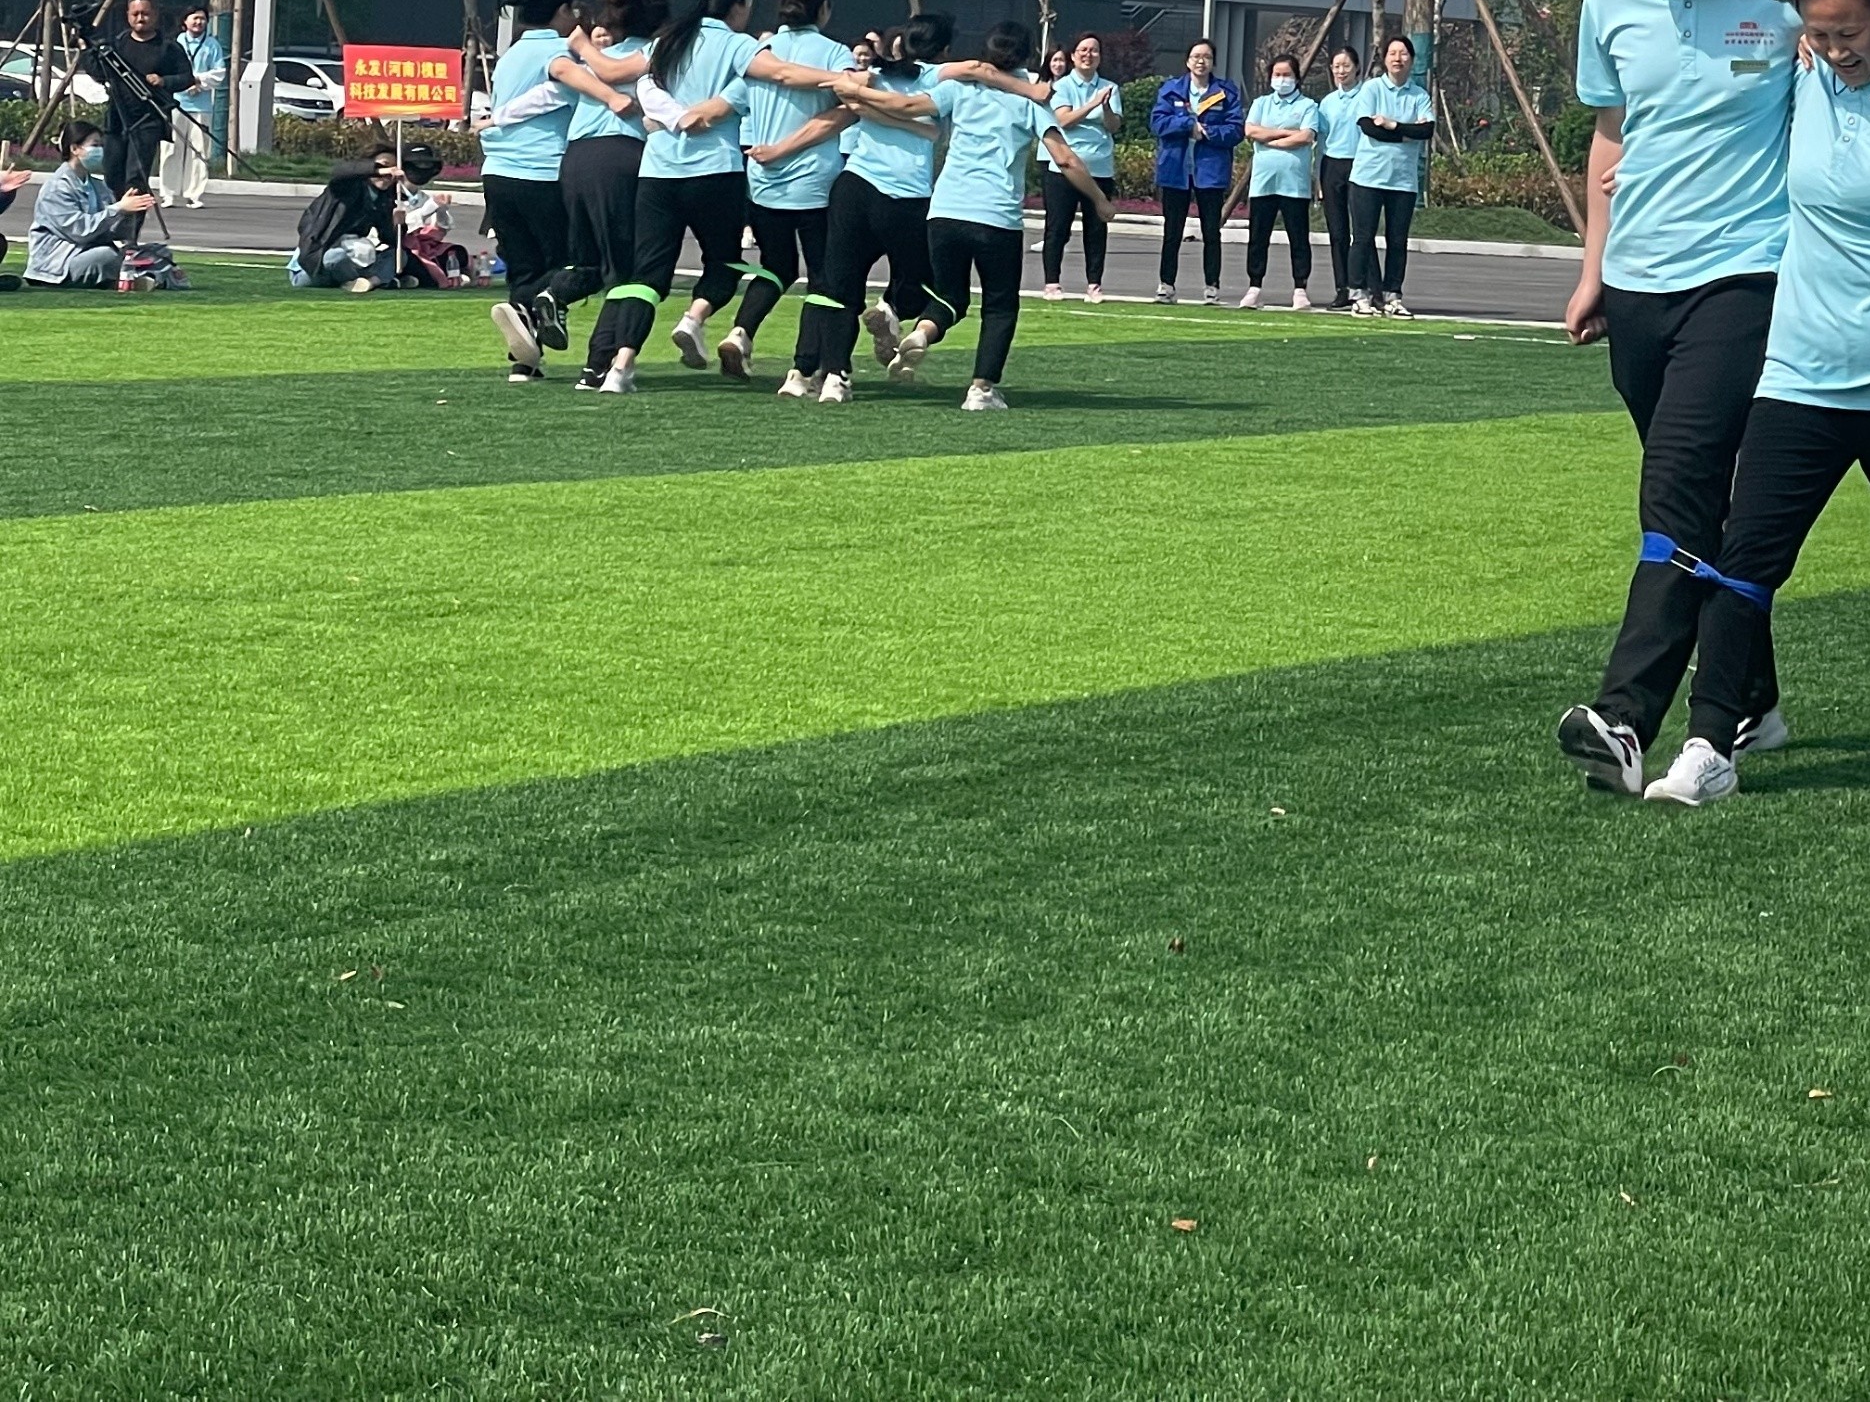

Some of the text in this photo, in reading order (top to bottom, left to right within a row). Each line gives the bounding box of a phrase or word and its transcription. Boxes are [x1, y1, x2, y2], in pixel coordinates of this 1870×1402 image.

[349, 82, 457, 102] 科技发展有限公司
